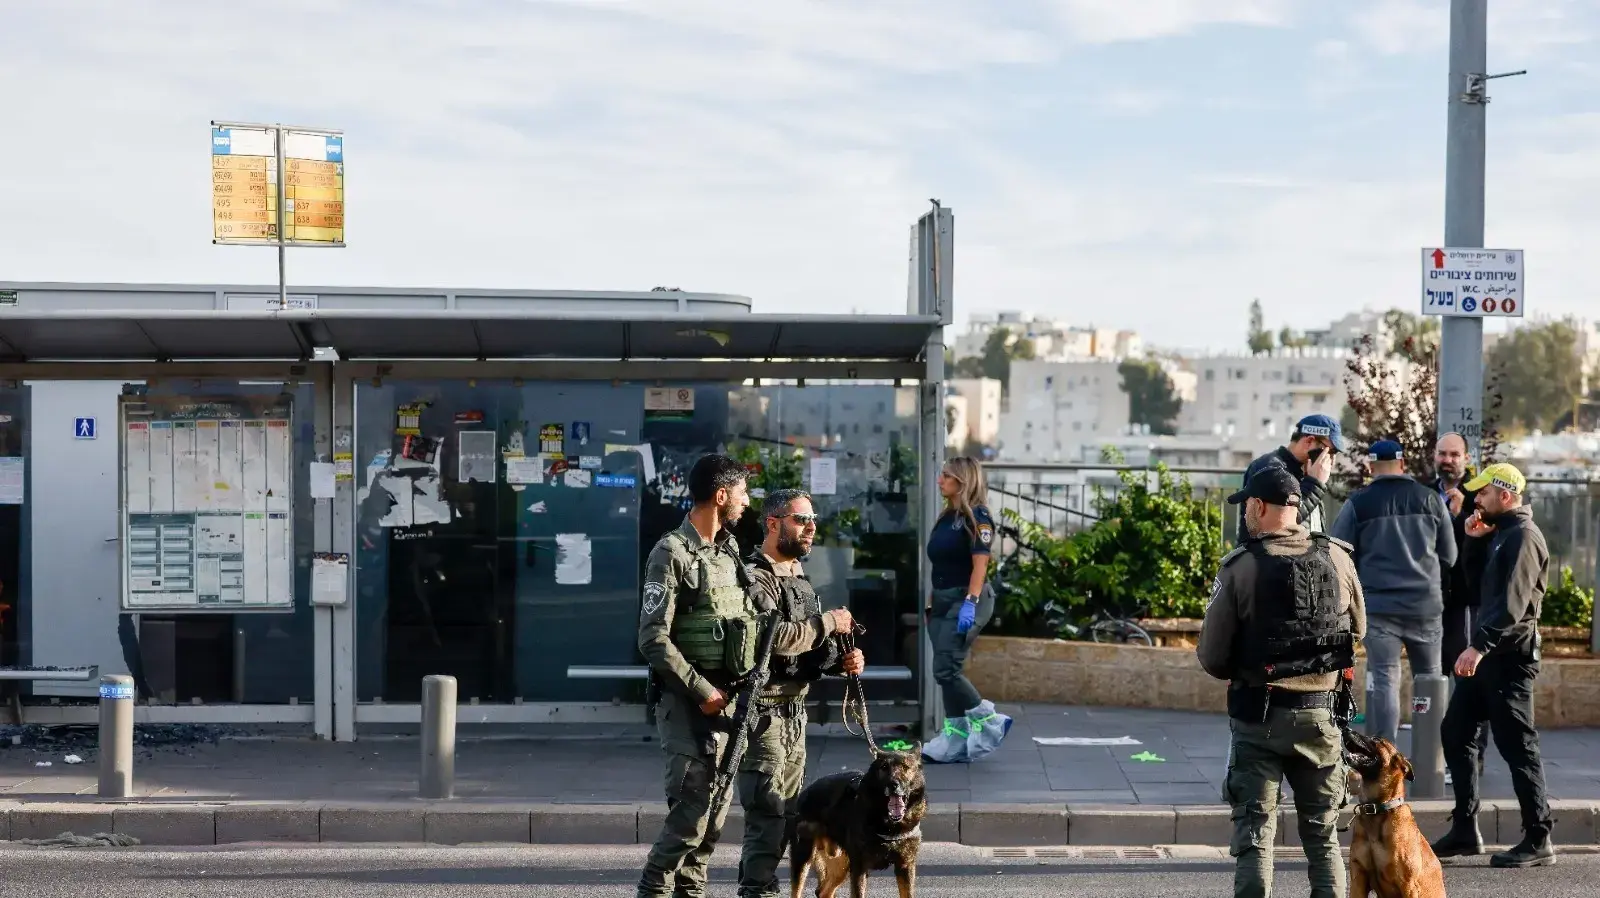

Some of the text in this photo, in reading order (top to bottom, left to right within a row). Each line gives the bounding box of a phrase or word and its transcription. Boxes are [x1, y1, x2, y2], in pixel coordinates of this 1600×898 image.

[296, 202, 310, 210] 637
[296, 216, 310, 224] 638
[1430, 270, 1516, 281] שירותים ציבוריים
[1462, 285, 1480, 293] W.C.
[1483, 284, 1516, 295] مراحيض
[1426, 288, 1454, 306] פעיל
[1459, 407, 1473, 420] 12
[1303, 425, 1329, 435] POLICE
[1452, 422, 1480, 437] 1200
[1492, 477, 1517, 492] בטחון
